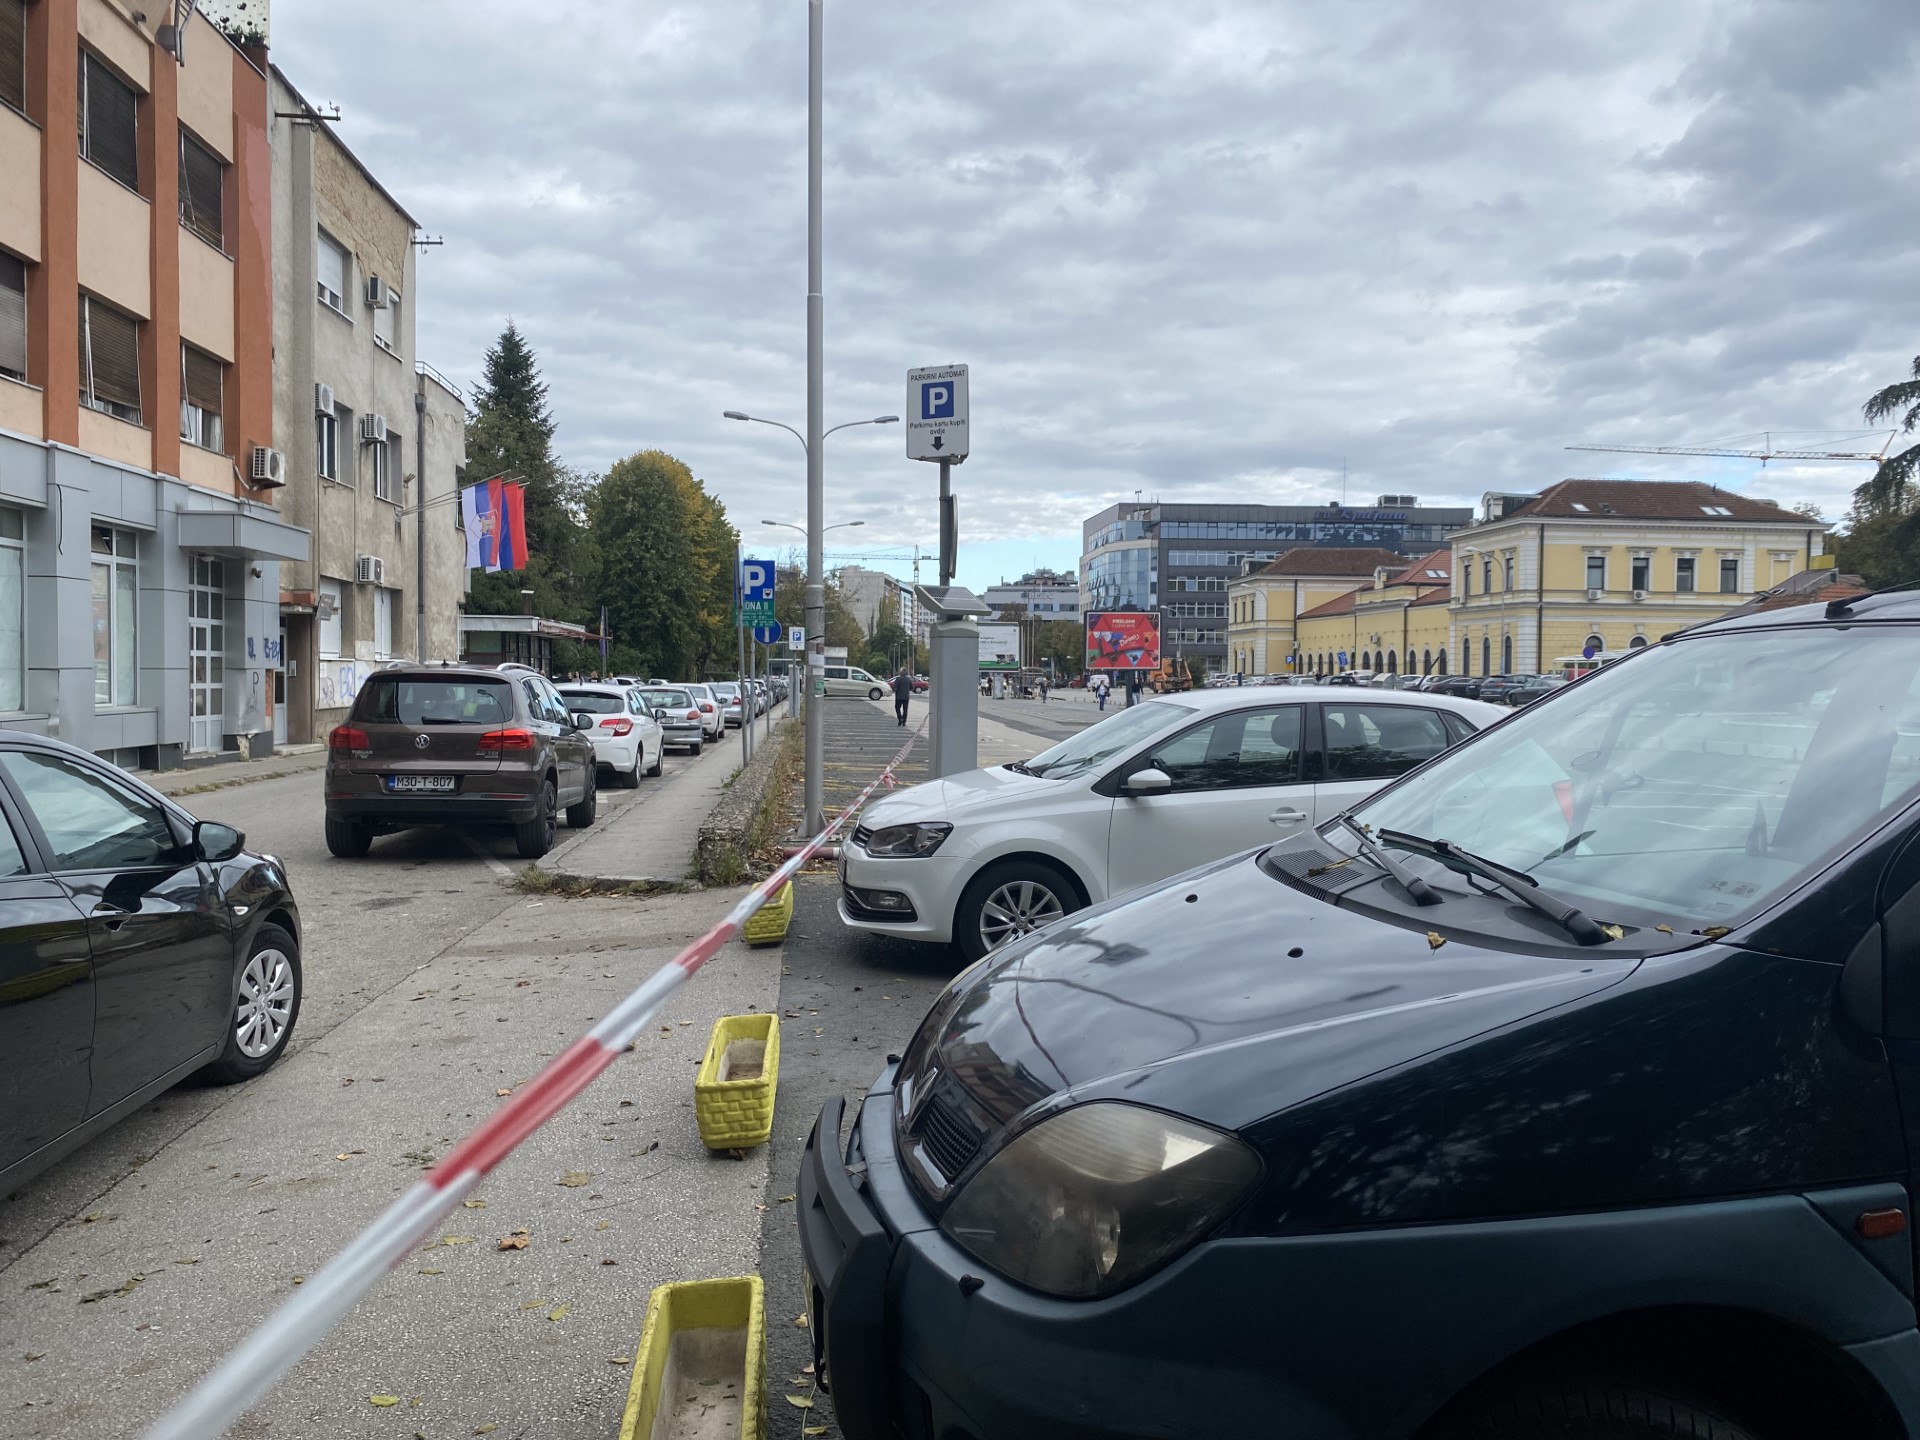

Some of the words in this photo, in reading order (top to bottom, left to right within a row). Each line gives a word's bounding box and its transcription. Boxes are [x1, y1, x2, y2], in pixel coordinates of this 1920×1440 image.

[910, 373, 937, 381] PARKIRNI
[938, 369, 965, 379] AUTOMAT
[929, 387, 948, 415] P
[744, 565, 766, 595] P
[744, 601, 762, 611] ONA
[794, 632, 800, 640] P
[396, 776, 453, 788] M30-T-807
